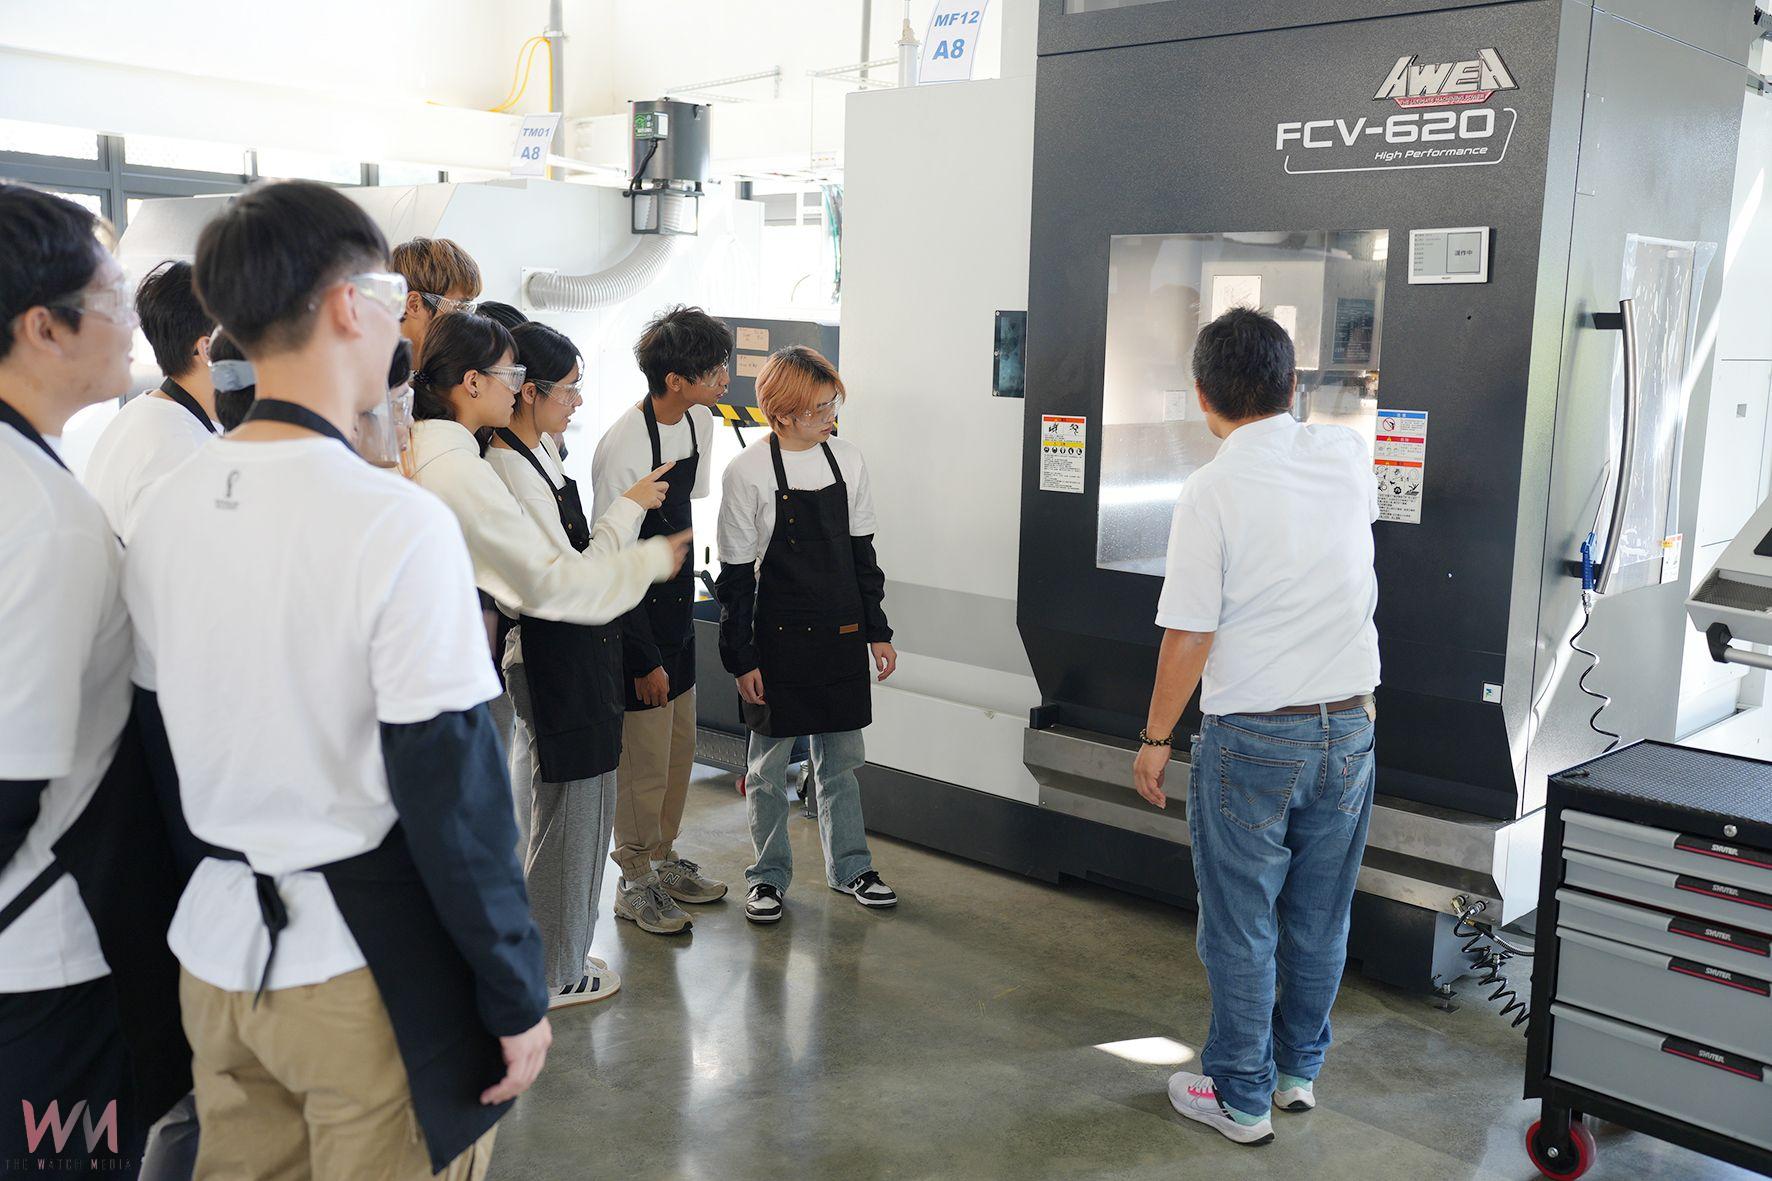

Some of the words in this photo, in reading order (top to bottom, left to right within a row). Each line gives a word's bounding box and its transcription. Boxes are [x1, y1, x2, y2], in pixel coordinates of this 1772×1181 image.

[934, 10, 980, 27] MF12
[932, 38, 966, 60] A8
[1372, 47, 1519, 101] AWEA
[523, 127, 551, 137] TM01
[1276, 108, 1496, 150] FCV-620
[520, 146, 541, 160] A8
[1374, 151, 1401, 161] High
[1405, 146, 1488, 159] Performance
